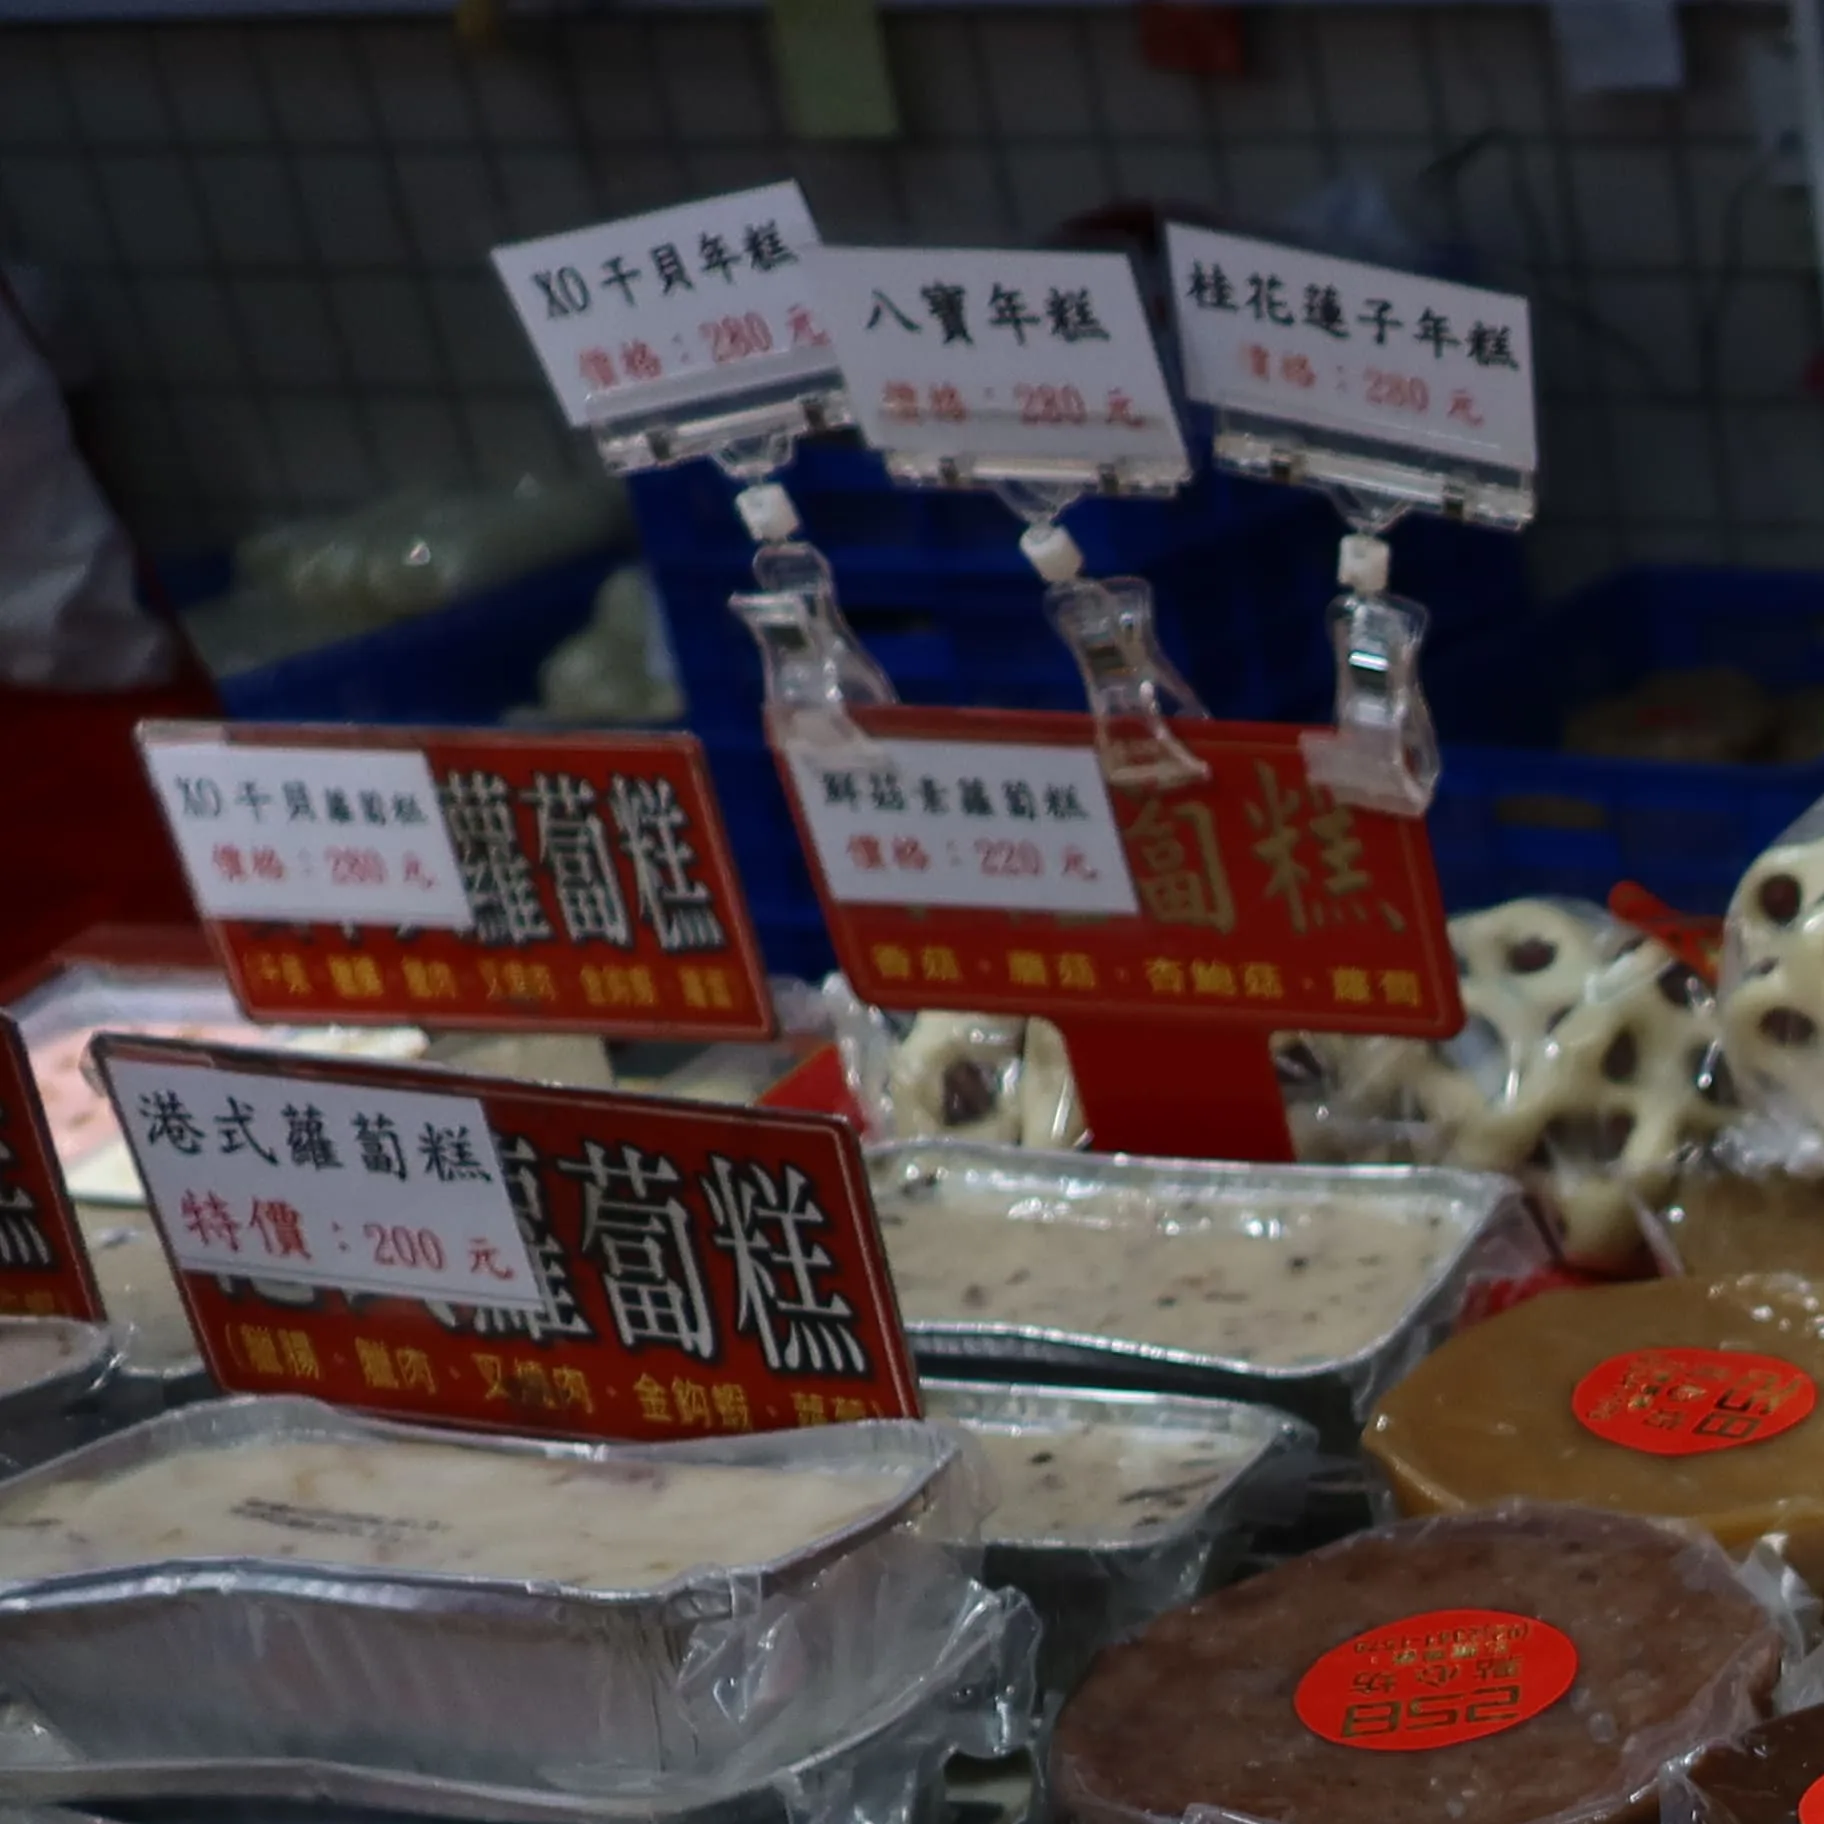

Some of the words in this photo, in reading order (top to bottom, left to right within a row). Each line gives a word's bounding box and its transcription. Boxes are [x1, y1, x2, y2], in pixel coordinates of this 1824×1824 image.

[533, 220, 799, 321] XO干貝年糕
[865, 280, 1112, 348] 八寶年糕
[1187, 258, 1521, 371] 桂花蓮子年糕
[140, 1089, 494, 1184] 港式蘿蔔糕
[1341, 1685, 1521, 1738] 258
